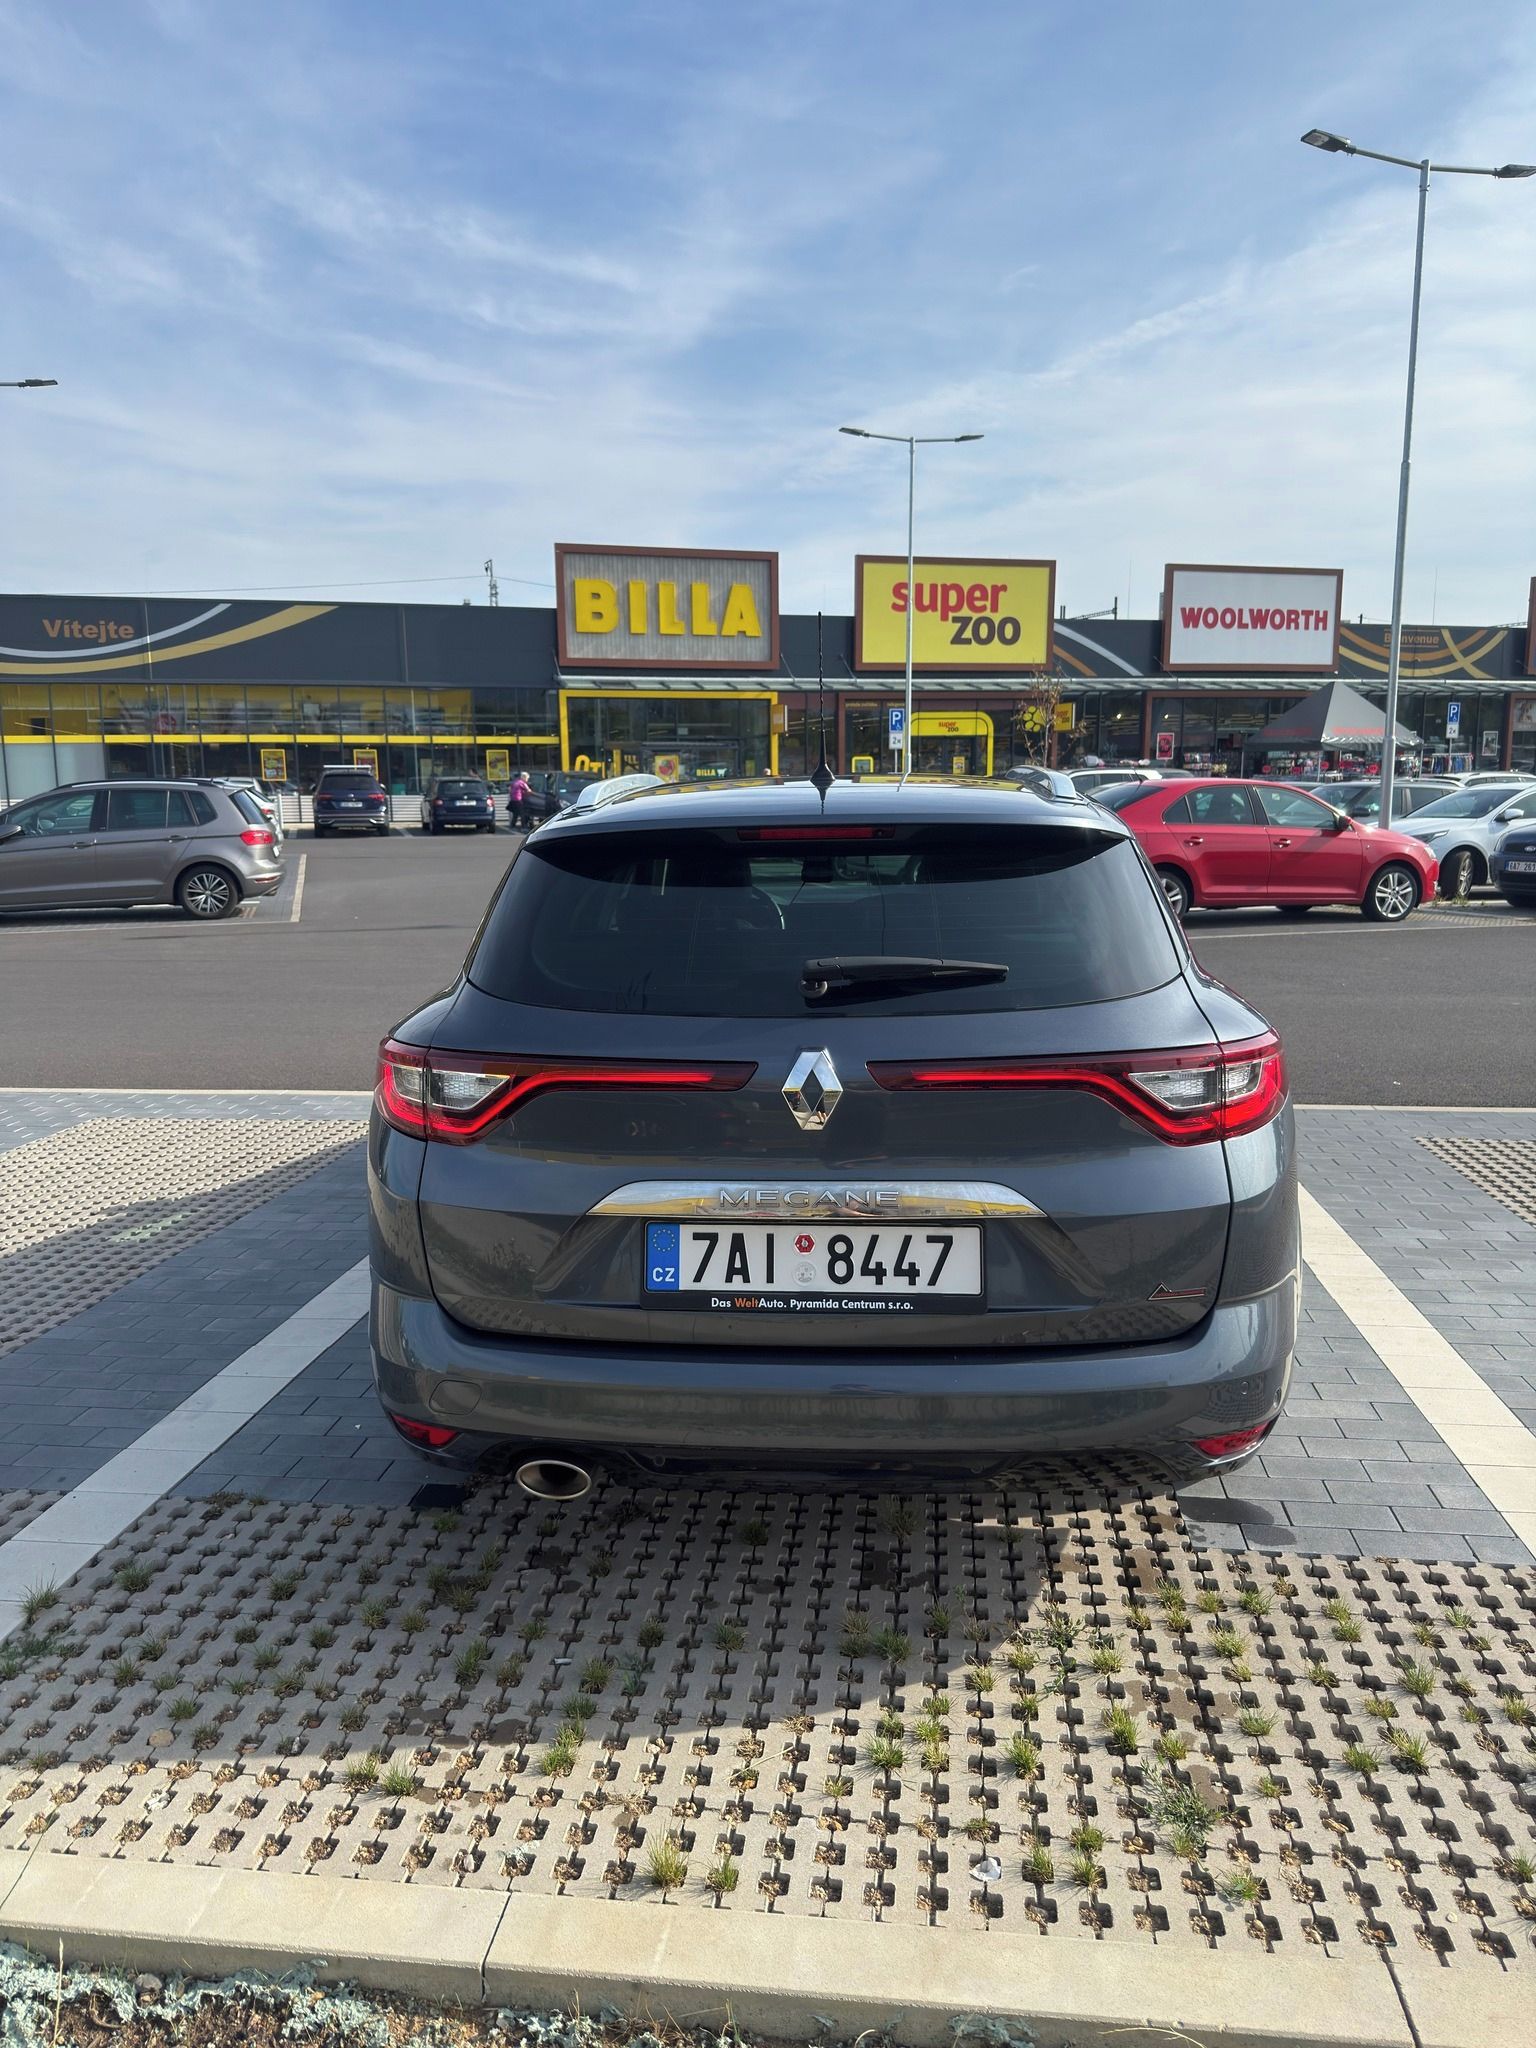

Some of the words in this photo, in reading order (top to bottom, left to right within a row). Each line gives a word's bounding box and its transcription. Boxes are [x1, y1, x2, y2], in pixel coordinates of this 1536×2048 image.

[574, 578, 762, 638] BILLA
[891, 582, 1008, 621] super
[1180, 607, 1328, 631] WOOLWORTH
[42, 618, 135, 644] Vítejte
[950, 616, 1021, 645] zoo
[1384, 632, 1439, 644] Bnvenue
[892, 711, 901, 725] P
[1450, 706, 1457, 716] P
[696, 768, 716, 777] BILLA
[719, 1189, 900, 1208] MEGANE
[692, 1232, 775, 1284] 7AI
[827, 1233, 954, 1286] 8447
[652, 1267, 675, 1283] CZ
[711, 1297, 731, 1309] Das
[734, 1297, 787, 1309] WeltAuto.
[790, 1298, 839, 1311] Pyramida
[841, 1299, 885, 1310] Centrum
[887, 1301, 914, 1311] s.r.o.
